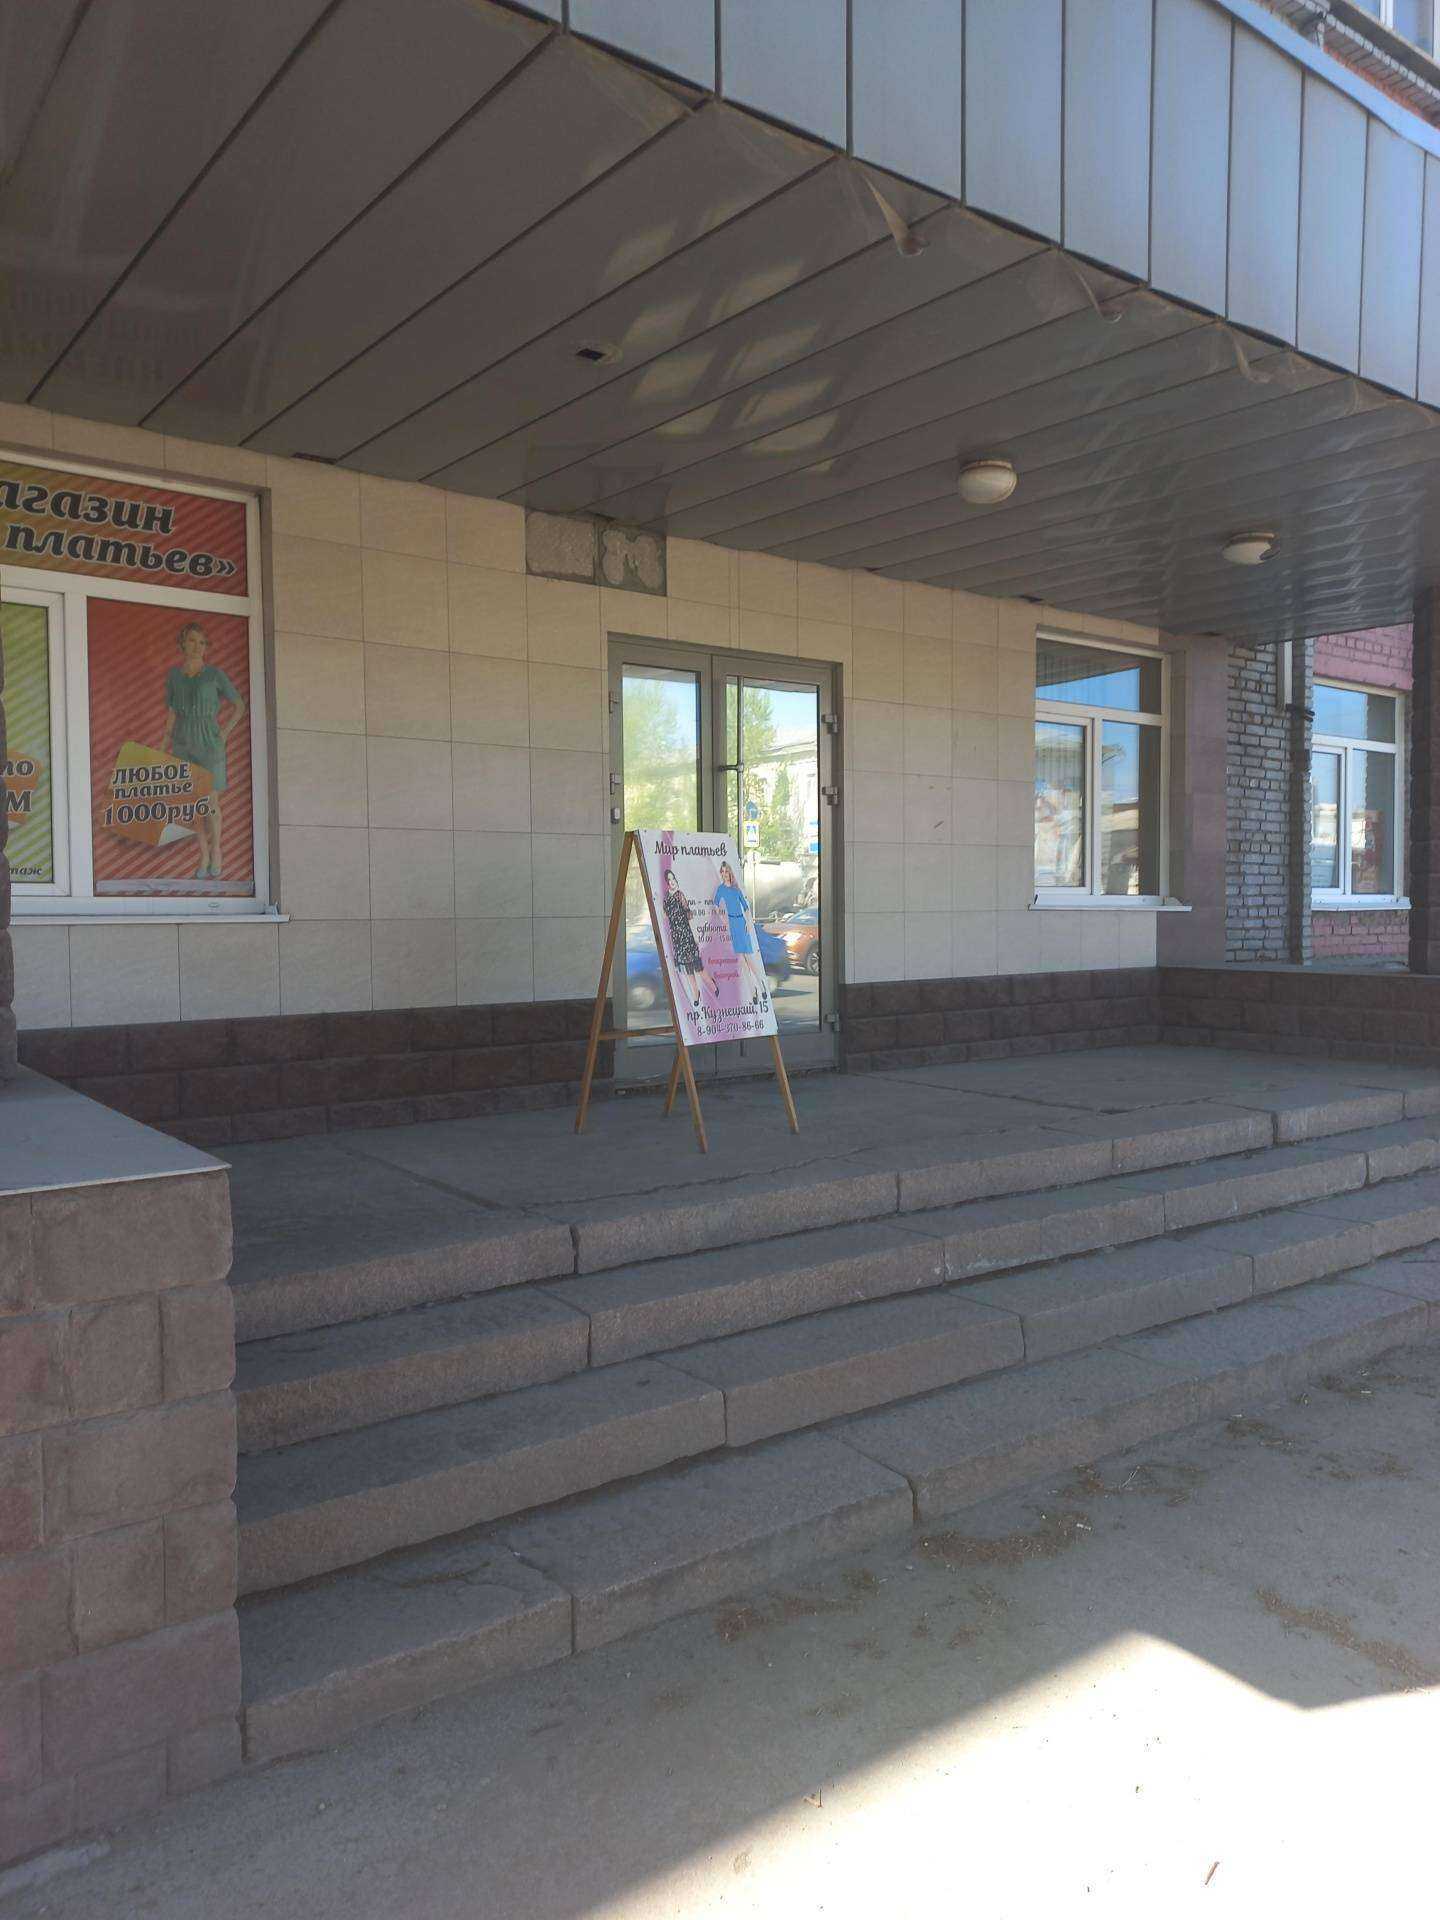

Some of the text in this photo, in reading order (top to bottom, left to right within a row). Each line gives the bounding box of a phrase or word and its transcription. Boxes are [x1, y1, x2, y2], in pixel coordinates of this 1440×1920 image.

[6, 524, 237, 576] платьев»
[113, 762, 191, 784] ЛЮБОЕ
[115, 781, 192, 800] платье
[654, 840, 728, 861] Мир платьев
[760, 1001, 769, 1014] 15
